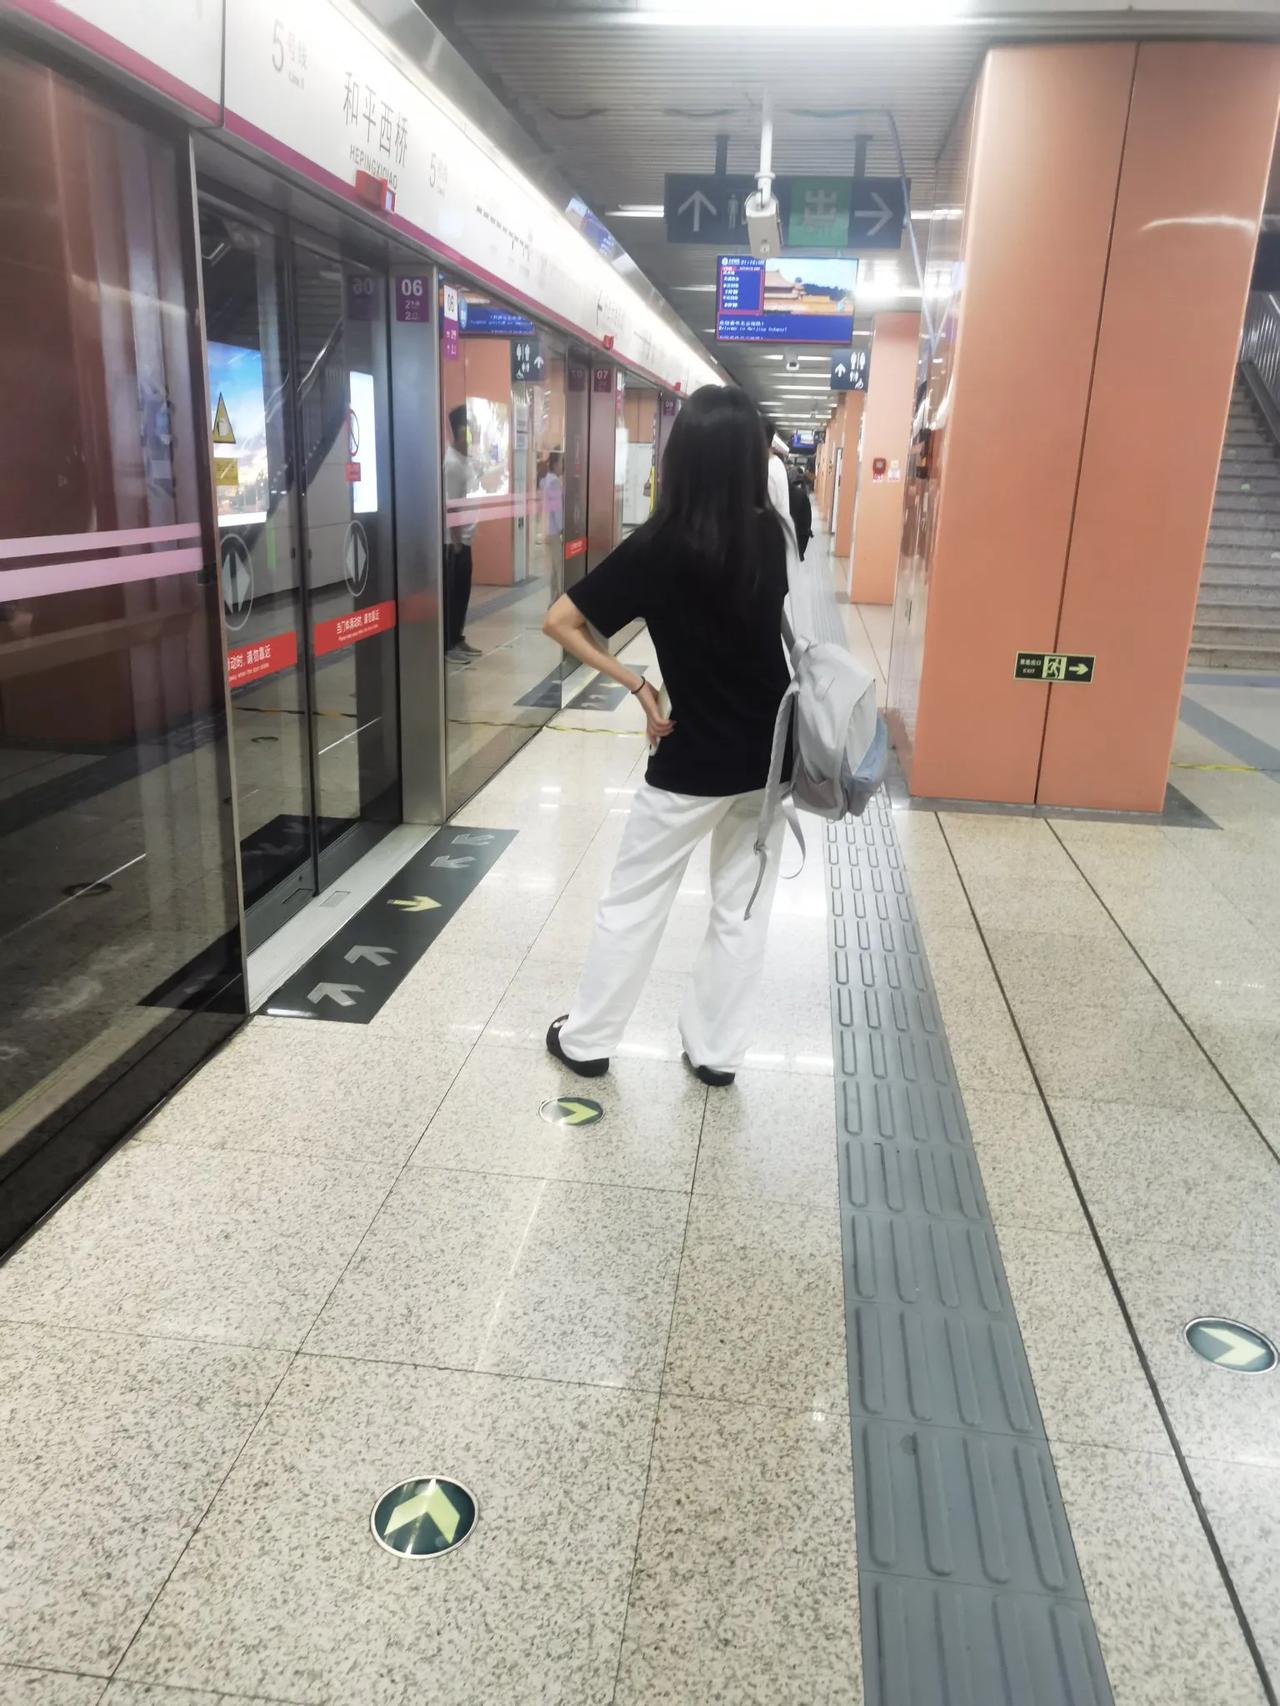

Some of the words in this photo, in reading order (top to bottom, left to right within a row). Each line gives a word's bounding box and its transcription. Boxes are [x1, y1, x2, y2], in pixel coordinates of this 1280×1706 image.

[343, 71, 408, 168] 和平西桥
[804, 189, 838, 224] 出
[401, 279, 423, 297] 06
